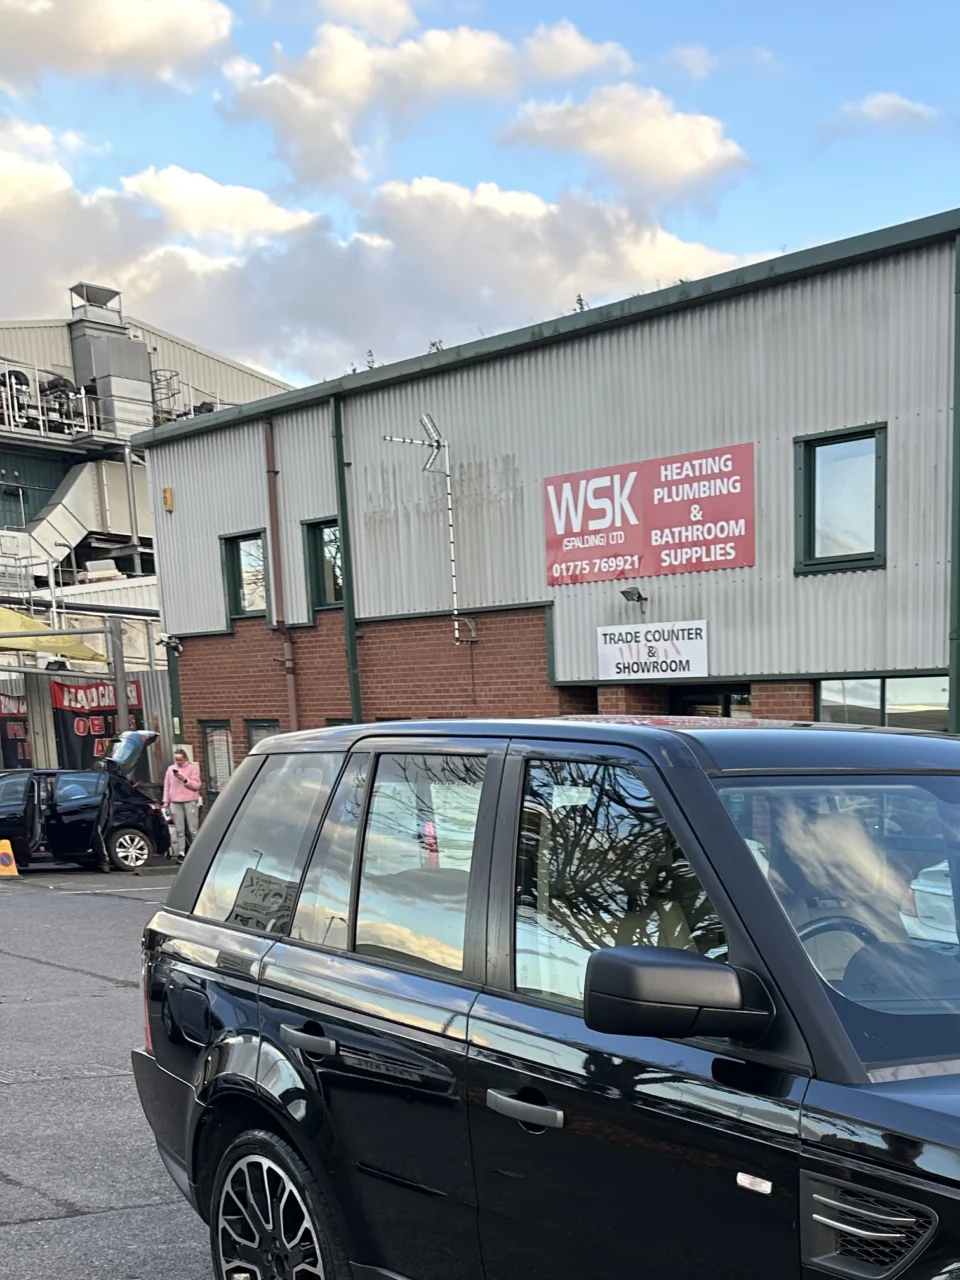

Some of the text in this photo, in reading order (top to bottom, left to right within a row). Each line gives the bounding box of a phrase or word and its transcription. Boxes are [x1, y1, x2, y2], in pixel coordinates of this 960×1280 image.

[660, 454, 733, 481] HEATING
[653, 476, 741, 504] PLUMBING
[547, 471, 639, 535] WSK
[690, 504, 703, 521] &
[563, 531, 624, 552] (SPALDING) LTD
[651, 519, 745, 546] BATHROOM
[660, 543, 736, 566] SUPPLIES
[552, 555, 639, 577] 01775 769921
[602, 627, 703, 645] TRADE COUNTER
[647, 645, 657, 658] &
[615, 659, 691, 675] SHOWROOM
[98, 685, 116, 706] CAR
